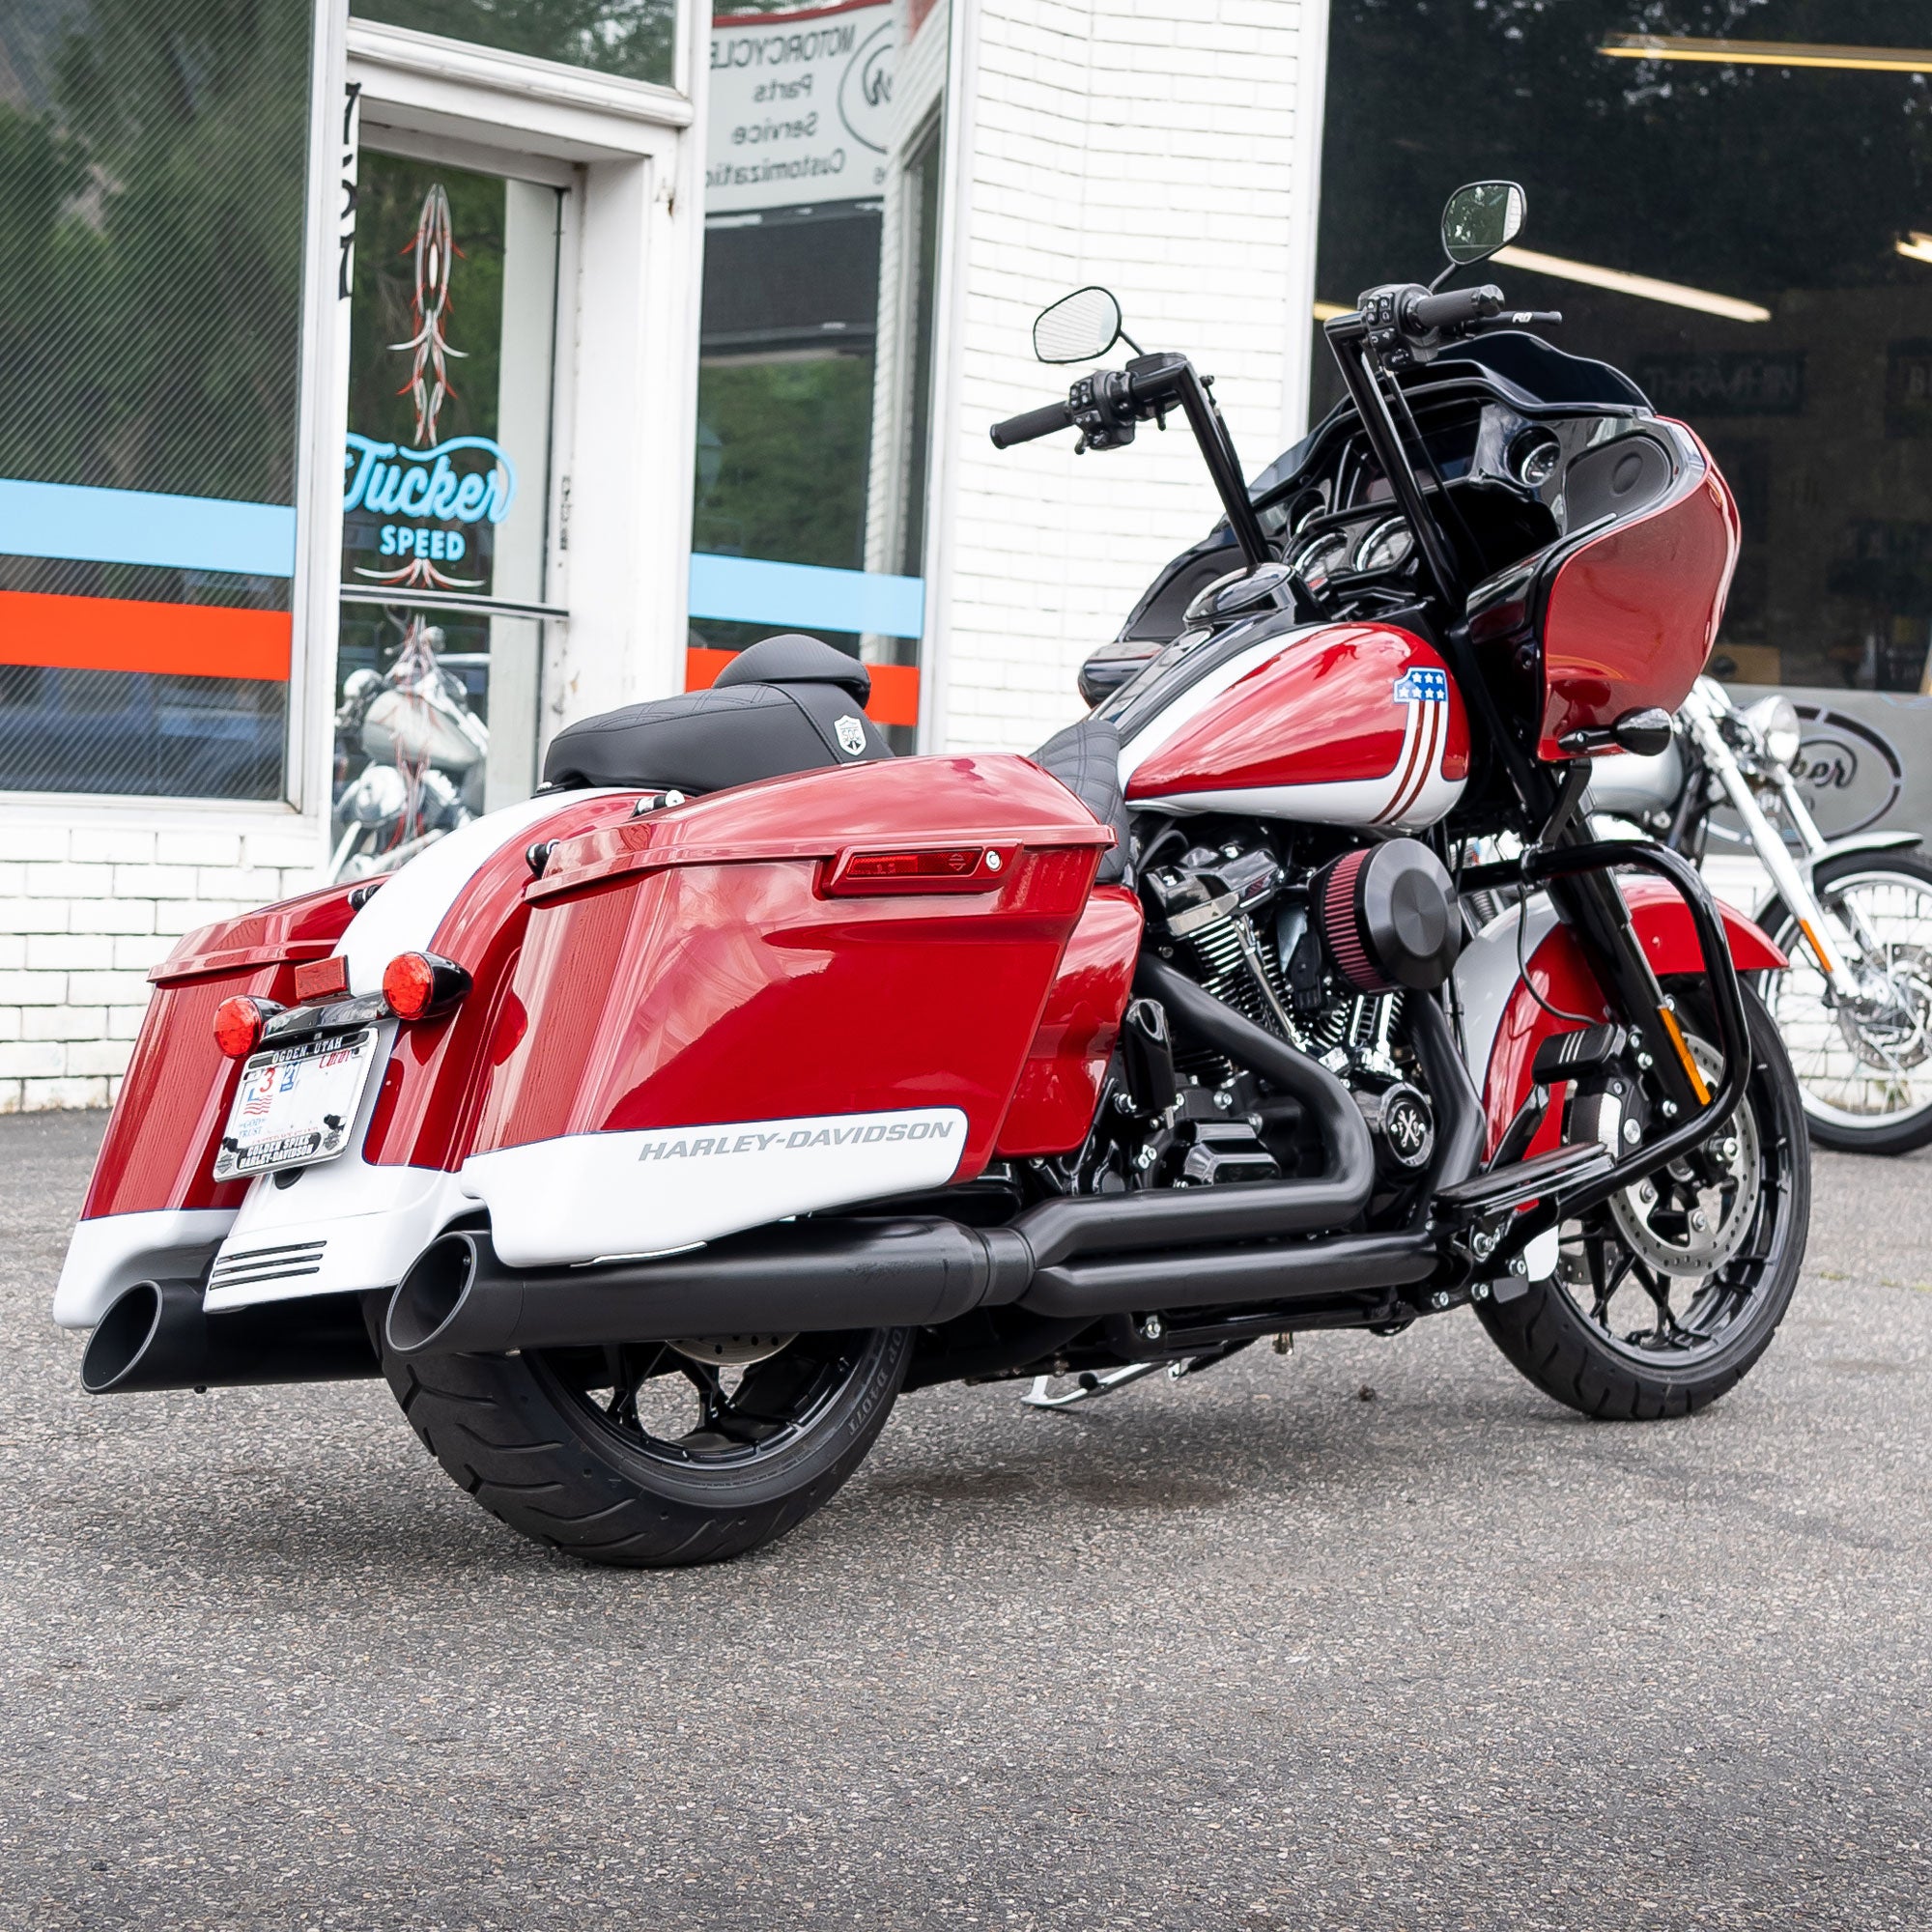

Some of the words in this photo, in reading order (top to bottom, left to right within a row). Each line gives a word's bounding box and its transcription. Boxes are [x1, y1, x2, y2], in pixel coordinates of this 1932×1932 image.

[344, 432, 519, 524] Tucker
[380, 524, 467, 561] SPEED
[313, 1037, 343, 1054] UTAH
[239, 1143, 314, 1169] HARLEY-DAVIDSON
[638, 1121, 954, 1161] HARLEY-DAVIDSON
